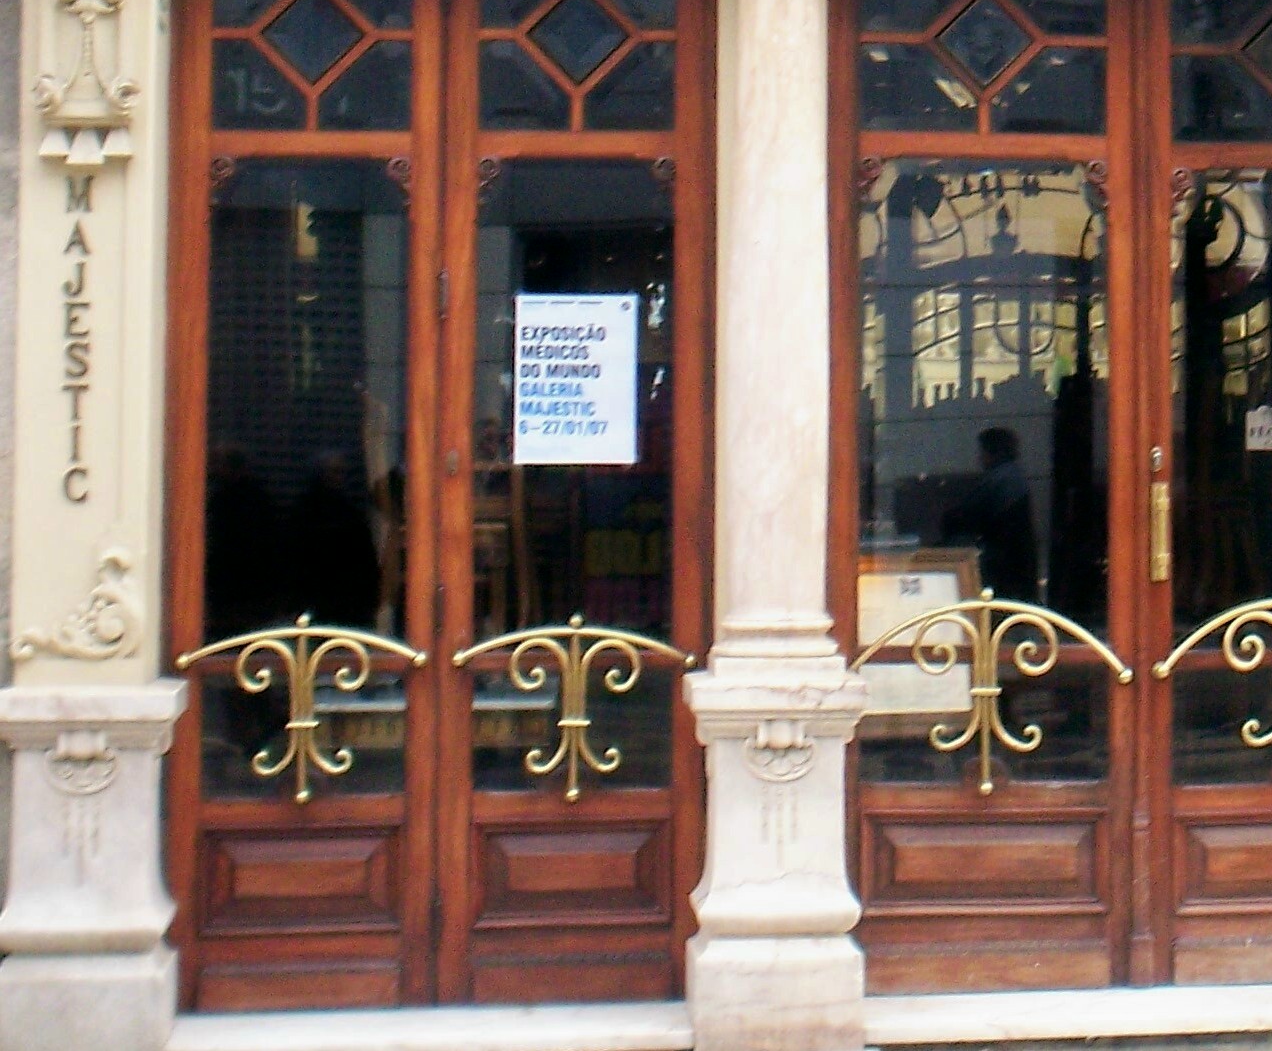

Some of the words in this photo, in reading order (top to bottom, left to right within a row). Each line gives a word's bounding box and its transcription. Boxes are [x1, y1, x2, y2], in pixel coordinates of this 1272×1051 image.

[60, 174, 95, 504] MAJESTIC
[520, 323, 607, 343] EXPOSIÇÃO
[519, 363, 541, 378] DO
[545, 363, 602, 379] MUNDO
[519, 381, 584, 397] GALERIA
[519, 400, 597, 417] MAJESTIC
